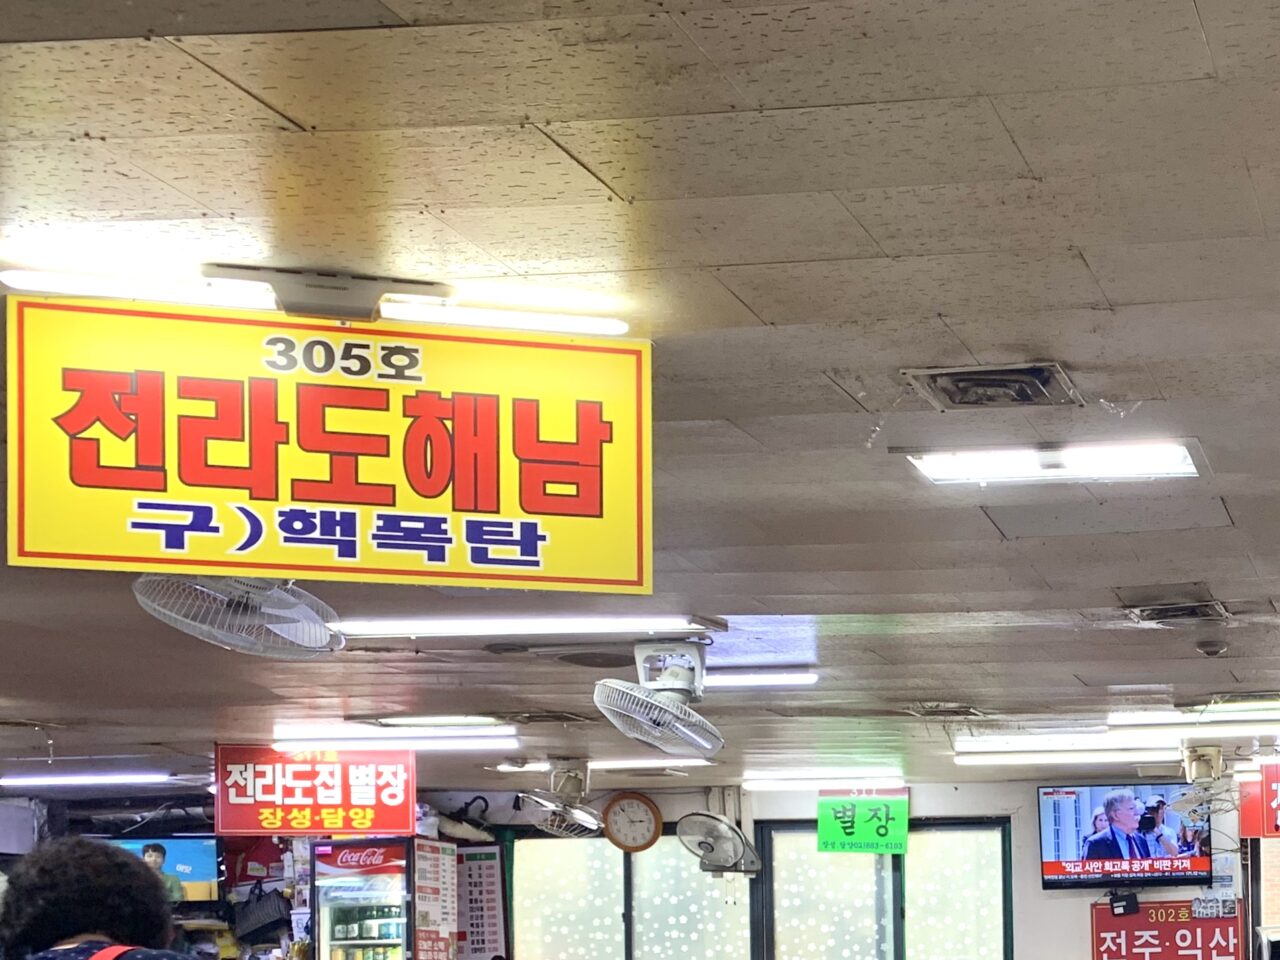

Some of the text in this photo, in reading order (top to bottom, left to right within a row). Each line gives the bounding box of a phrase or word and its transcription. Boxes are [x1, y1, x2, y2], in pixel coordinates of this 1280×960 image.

[265, 336, 423, 382] 305호
[52, 367, 614, 518] 전라도해남
[225, 763, 407, 806] 전라도집 별장
[1148, 908, 1191, 922] 302호
